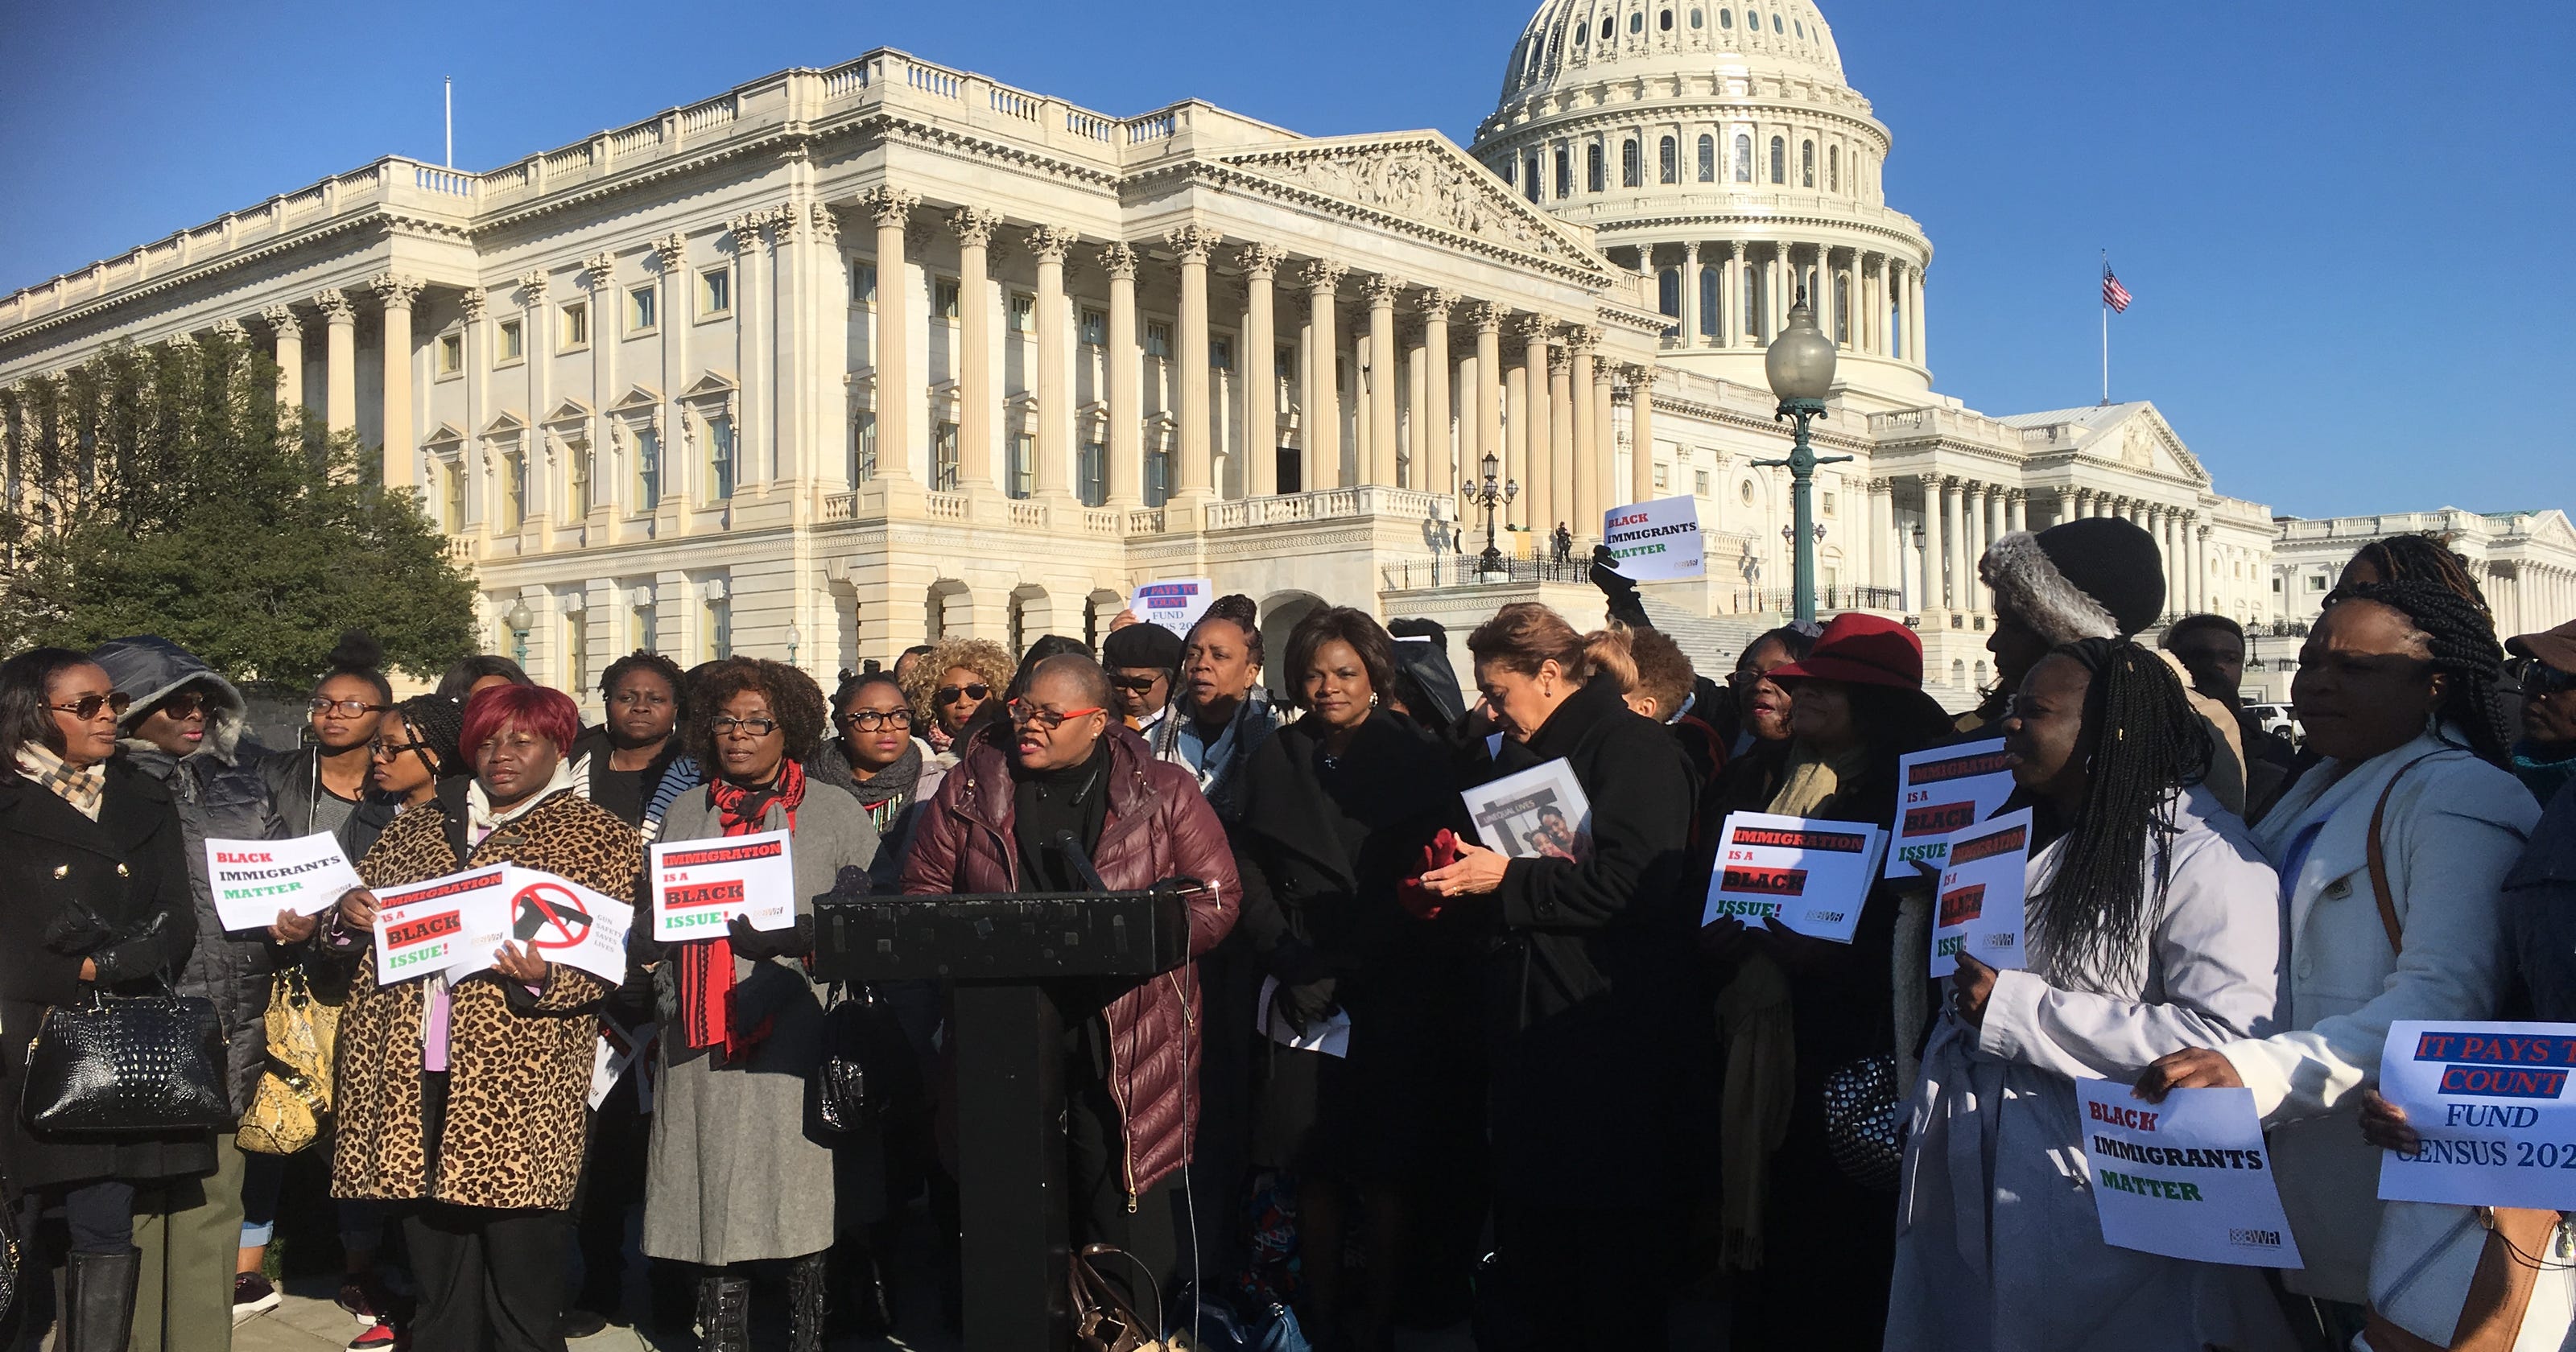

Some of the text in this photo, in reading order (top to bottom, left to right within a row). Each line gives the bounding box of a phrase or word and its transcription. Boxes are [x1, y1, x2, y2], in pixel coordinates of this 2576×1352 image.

[1608, 513, 1649, 528] BLACK
[1608, 522, 1697, 544] IMMIGRANTS
[1609, 543, 1666, 559] MATTER
[1150, 585, 1179, 595] PAYS
[1181, 584, 1198, 594] TO
[1148, 598, 1186, 608] COUNT
[1153, 611, 1184, 620] FUND
[1179, 622, 1193, 630] 20
[1909, 756, 2006, 781] IMMIGRATIO
[1907, 790, 1928, 803] IS A
[1483, 800, 1536, 823] UNEQUAL LIVES
[1905, 808, 1975, 832] BLACK
[1733, 830, 1864, 850] IMMIGRATION
[1951, 830, 2025, 862] IMMIGRATION
[217, 852, 273, 864] BLACK
[663, 843, 781, 867] IMMIGRATION
[1728, 851, 1753, 860] IS A
[220, 855, 341, 881] IMMIGRANTS
[663, 872, 688, 882] IS A
[1724, 871, 1807, 891] BLACK
[1944, 872, 1957, 886] IS A
[223, 881, 304, 900] MATTER
[381, 873, 502, 908] IMMIGRATION
[665, 884, 744, 905] BLACK
[1716, 900, 1782, 917] ISSUE!
[1942, 891, 1985, 920] BLACK
[381, 910, 405, 923] IS A
[597, 914, 613, 925] GUN
[666, 910, 729, 929] ISSUE!
[387, 913, 461, 945] BLACK
[595, 932, 617, 945] SAVES
[596, 923, 623, 938] SAFETY
[594, 940, 615, 953] LIVES
[1938, 933, 1967, 957] ISSU!
[390, 942, 448, 969] ISSUE!
[2416, 1036, 2576, 1063] IT PAYS T
[2442, 1068, 2567, 1094] COUNT
[2088, 1100, 2159, 1131] BLACK
[2446, 1104, 2539, 1128] FUND
[2093, 1135, 2264, 1170] IMMIGRANTS
[2516, 1142, 2576, 1169] 202
[2099, 1169, 2203, 1202] MATTER
